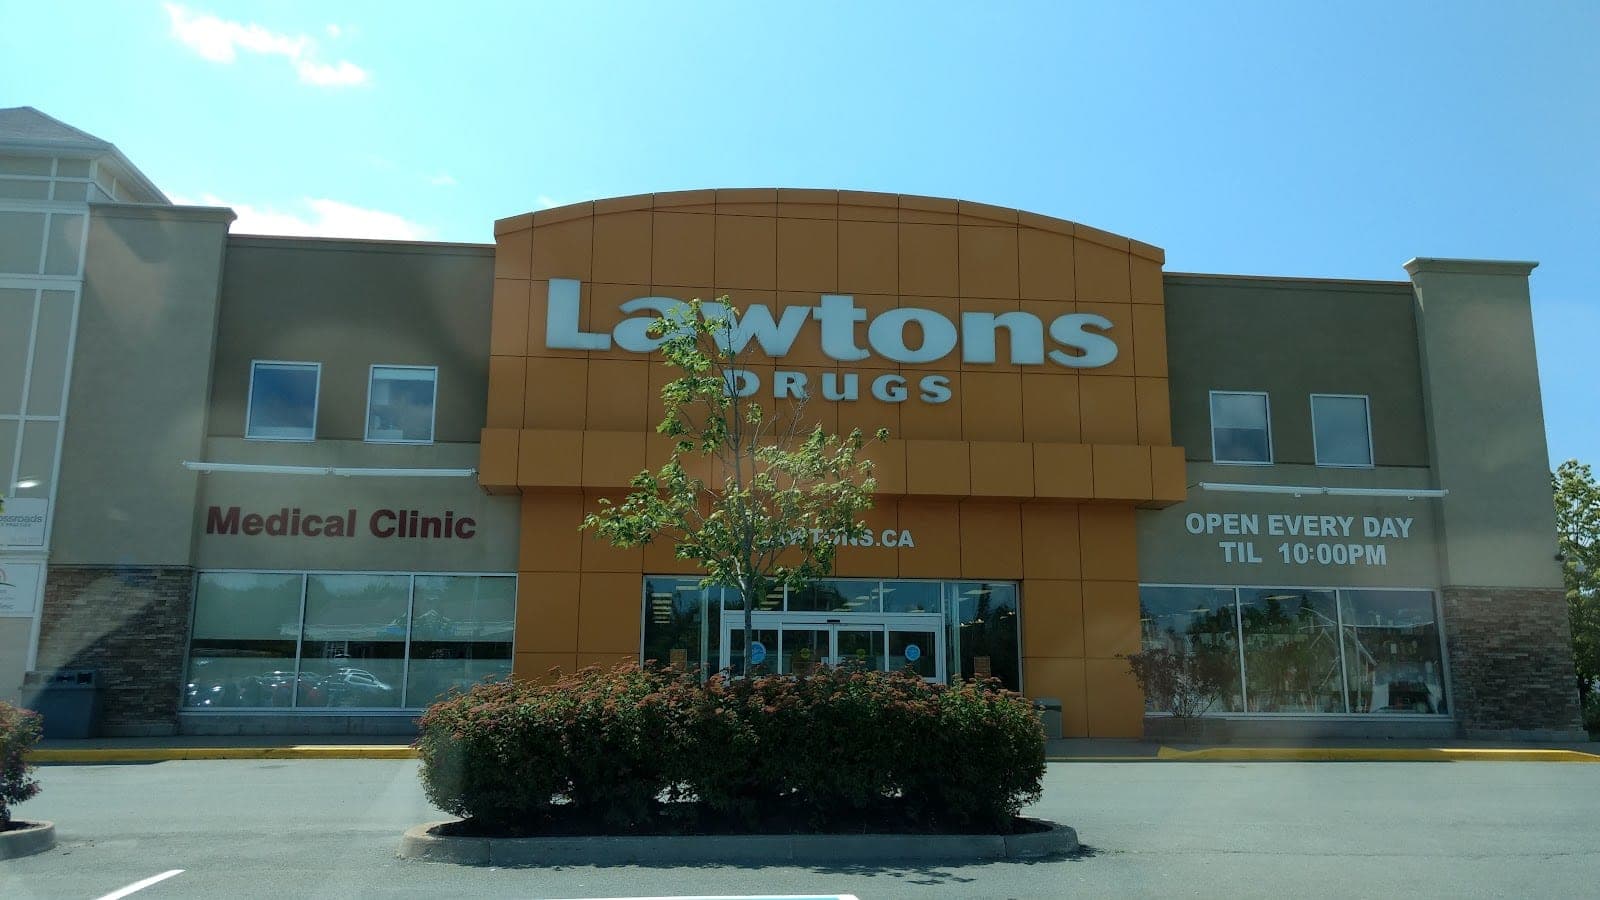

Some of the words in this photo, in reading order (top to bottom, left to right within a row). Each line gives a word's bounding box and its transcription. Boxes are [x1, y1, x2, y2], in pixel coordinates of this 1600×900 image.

[545, 278, 1119, 368] Lawtons
[722, 369, 953, 403] DRUGS
[206, 506, 357, 538] Medical
[369, 509, 477, 539] Clinic
[1185, 513, 1259, 535] OPEN
[1268, 514, 1354, 537] EVERY
[1363, 517, 1413, 538] DAY
[1219, 541, 1263, 563] TIL
[1278, 543, 1387, 566] 10:00PM
